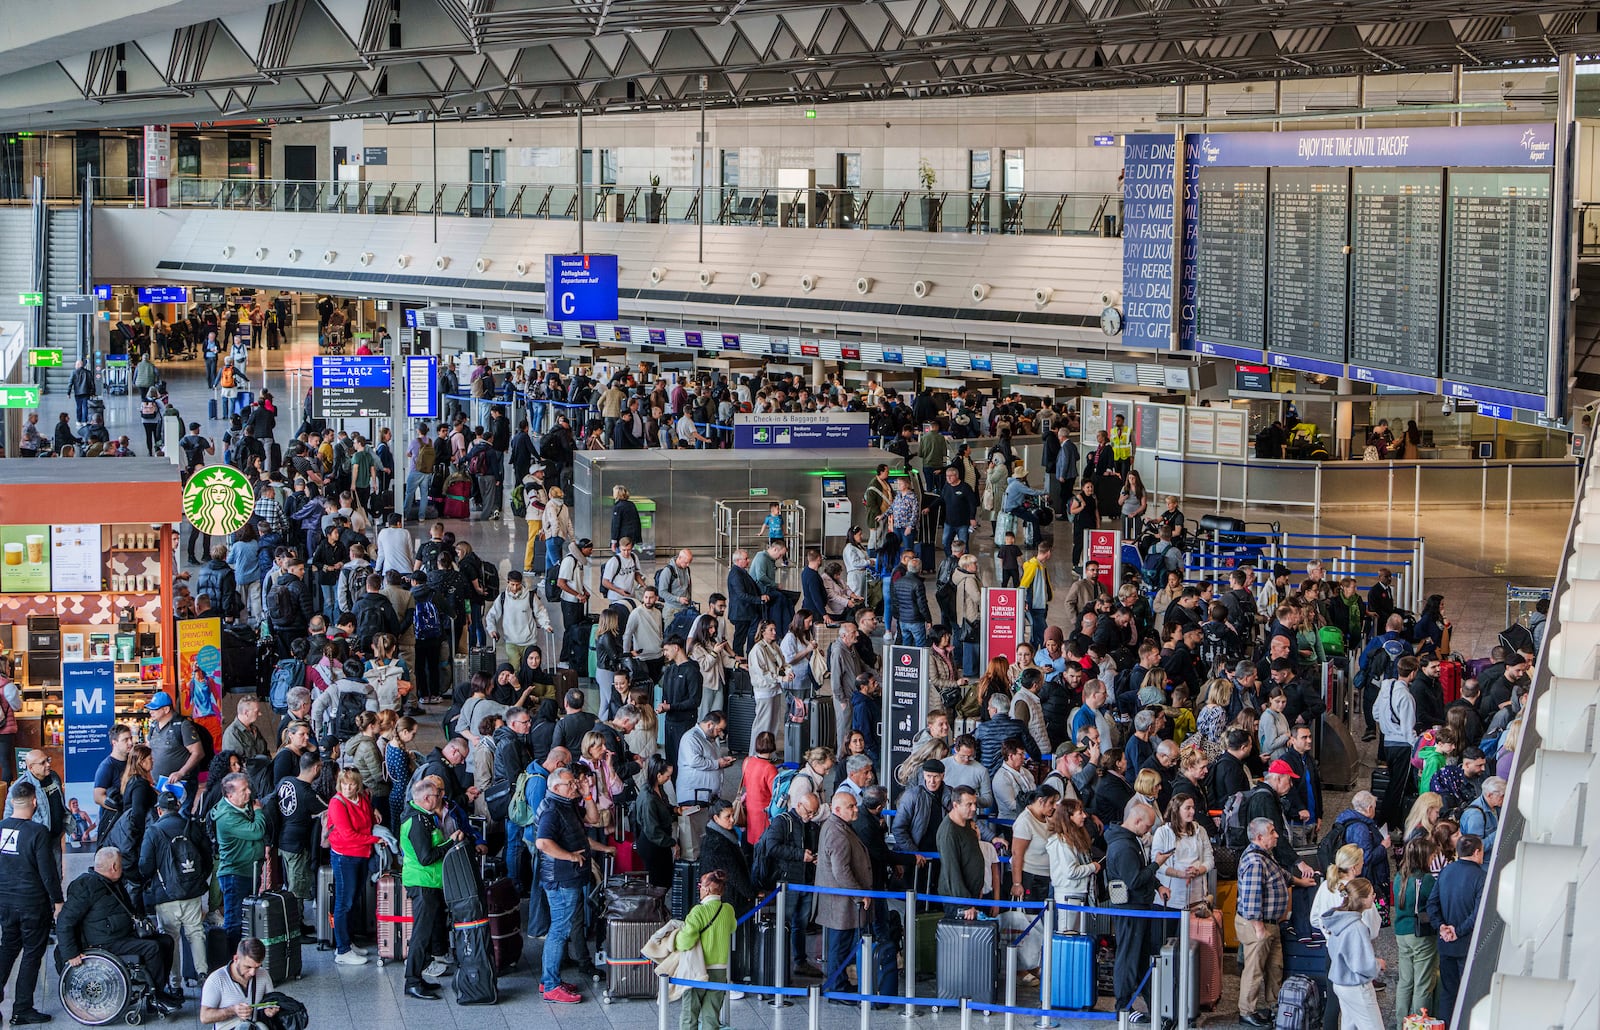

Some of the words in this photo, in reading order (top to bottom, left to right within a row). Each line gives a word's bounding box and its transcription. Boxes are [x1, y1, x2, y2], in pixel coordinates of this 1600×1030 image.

[1125, 144, 1149, 159] DINE
[1151, 144, 1175, 159] DINE
[1298, 138, 1320, 160] ENJOY
[1320, 138, 1334, 156] THE
[1335, 137, 1353, 156] TIME
[1354, 137, 1375, 156] UNTIL
[1377, 135, 1409, 156] TAKEOFF
[1137, 164, 1166, 179] DUTY
[1148, 204, 1174, 219] MILE
[561, 277, 588, 285] Departures
[1146, 283, 1171, 299] DEAL
[561, 292, 575, 315] C
[1147, 323, 1170, 338] GIFT
[790, 415, 817, 424] Baggage
[819, 415, 830, 423] tag
[182, 622, 208, 630] COLORFUL
[182, 640, 204, 648] SPECIALS
[76, 688, 102, 714] M
